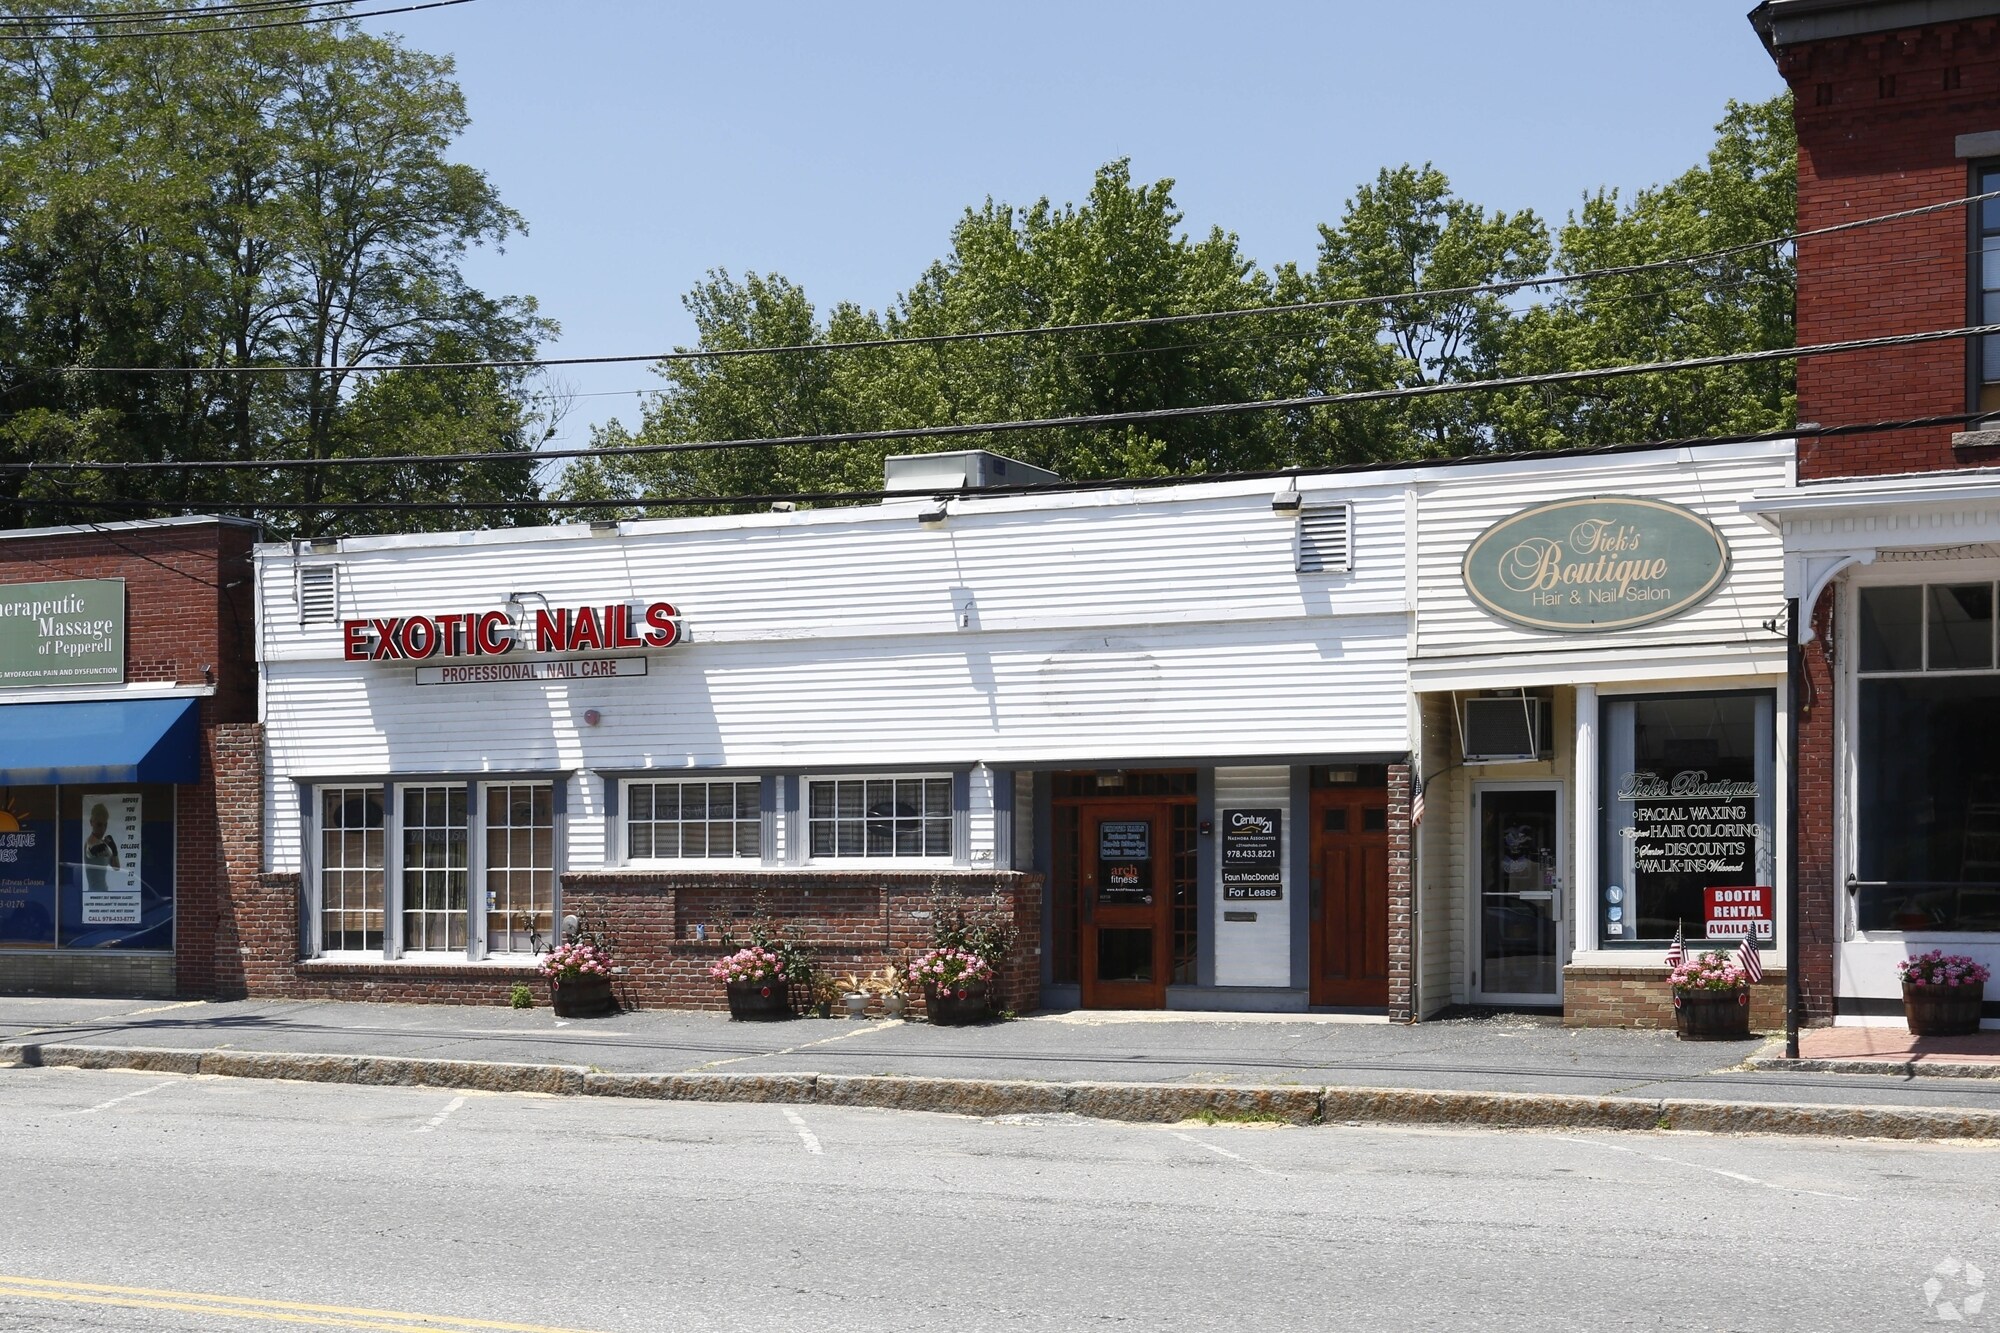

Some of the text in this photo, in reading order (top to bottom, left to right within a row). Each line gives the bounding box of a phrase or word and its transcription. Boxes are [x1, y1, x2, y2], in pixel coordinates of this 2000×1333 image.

[1569, 518, 1641, 555] Tick's
[1499, 537, 1668, 598] Boutique
[1533, 586, 1671, 606] Hair & Nail Salon
[38, 616, 113, 640] Massage
[344, 601, 682, 662] EXOTIC NAILS
[38, 638, 112, 657] of Pepperell
[4, 670, 42, 678] MYOFASCIAL
[74, 667, 118, 675] DYSFUNCTION
[442, 660, 617, 682] PROFESSIONAL NAIL CARE
[1671, 770, 1758, 803] Boutique
[1638, 806, 1746, 821] FACIAL WAXING
[1232, 813, 1272, 833] Century 21
[1650, 824, 1686, 838] HAIR
[1687, 823, 1761, 838] COLORING
[6, 833, 36, 847] SHINE
[1226, 850, 1276, 858] 978.433.8221
[1665, 842, 1745, 856] DISCOUNTS
[1111, 864, 1137, 876] arch
[1640, 859, 1707, 872] WALK-INS
[1111, 875, 1138, 886] fitness
[1224, 872, 1279, 881] Faun MacDonald
[1229, 887, 1277, 897] For Lease
[1715, 889, 1761, 902] BOOTH
[1713, 905, 1763, 917] RENTAL
[1709, 923, 1770, 934] AVAILALE
